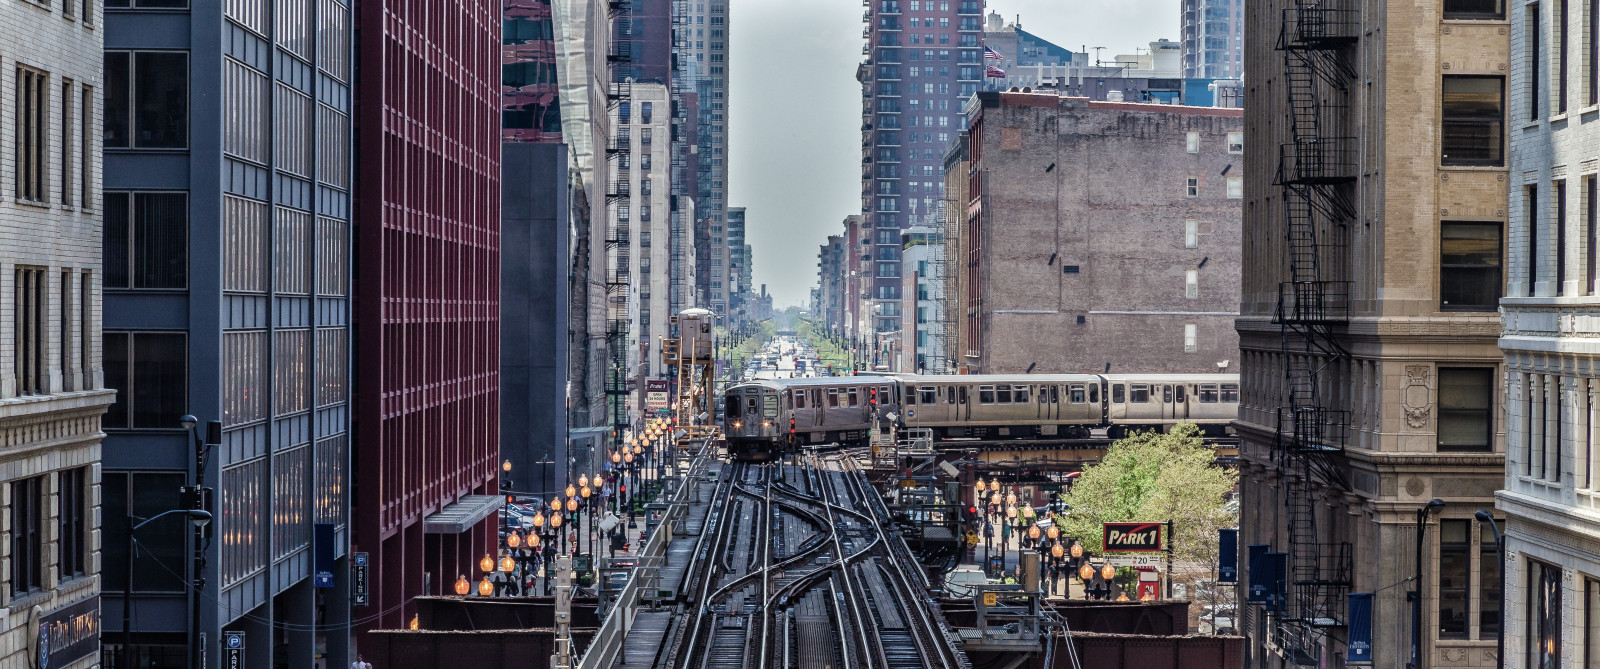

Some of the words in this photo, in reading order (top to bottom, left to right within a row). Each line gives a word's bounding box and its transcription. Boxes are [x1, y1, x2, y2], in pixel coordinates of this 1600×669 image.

[1108, 530, 1148, 545] PARK
[1149, 530, 1157, 545] 1
[357, 557, 364, 565] P
[1138, 556, 1148, 565] 20
[230, 638, 239, 646] P
